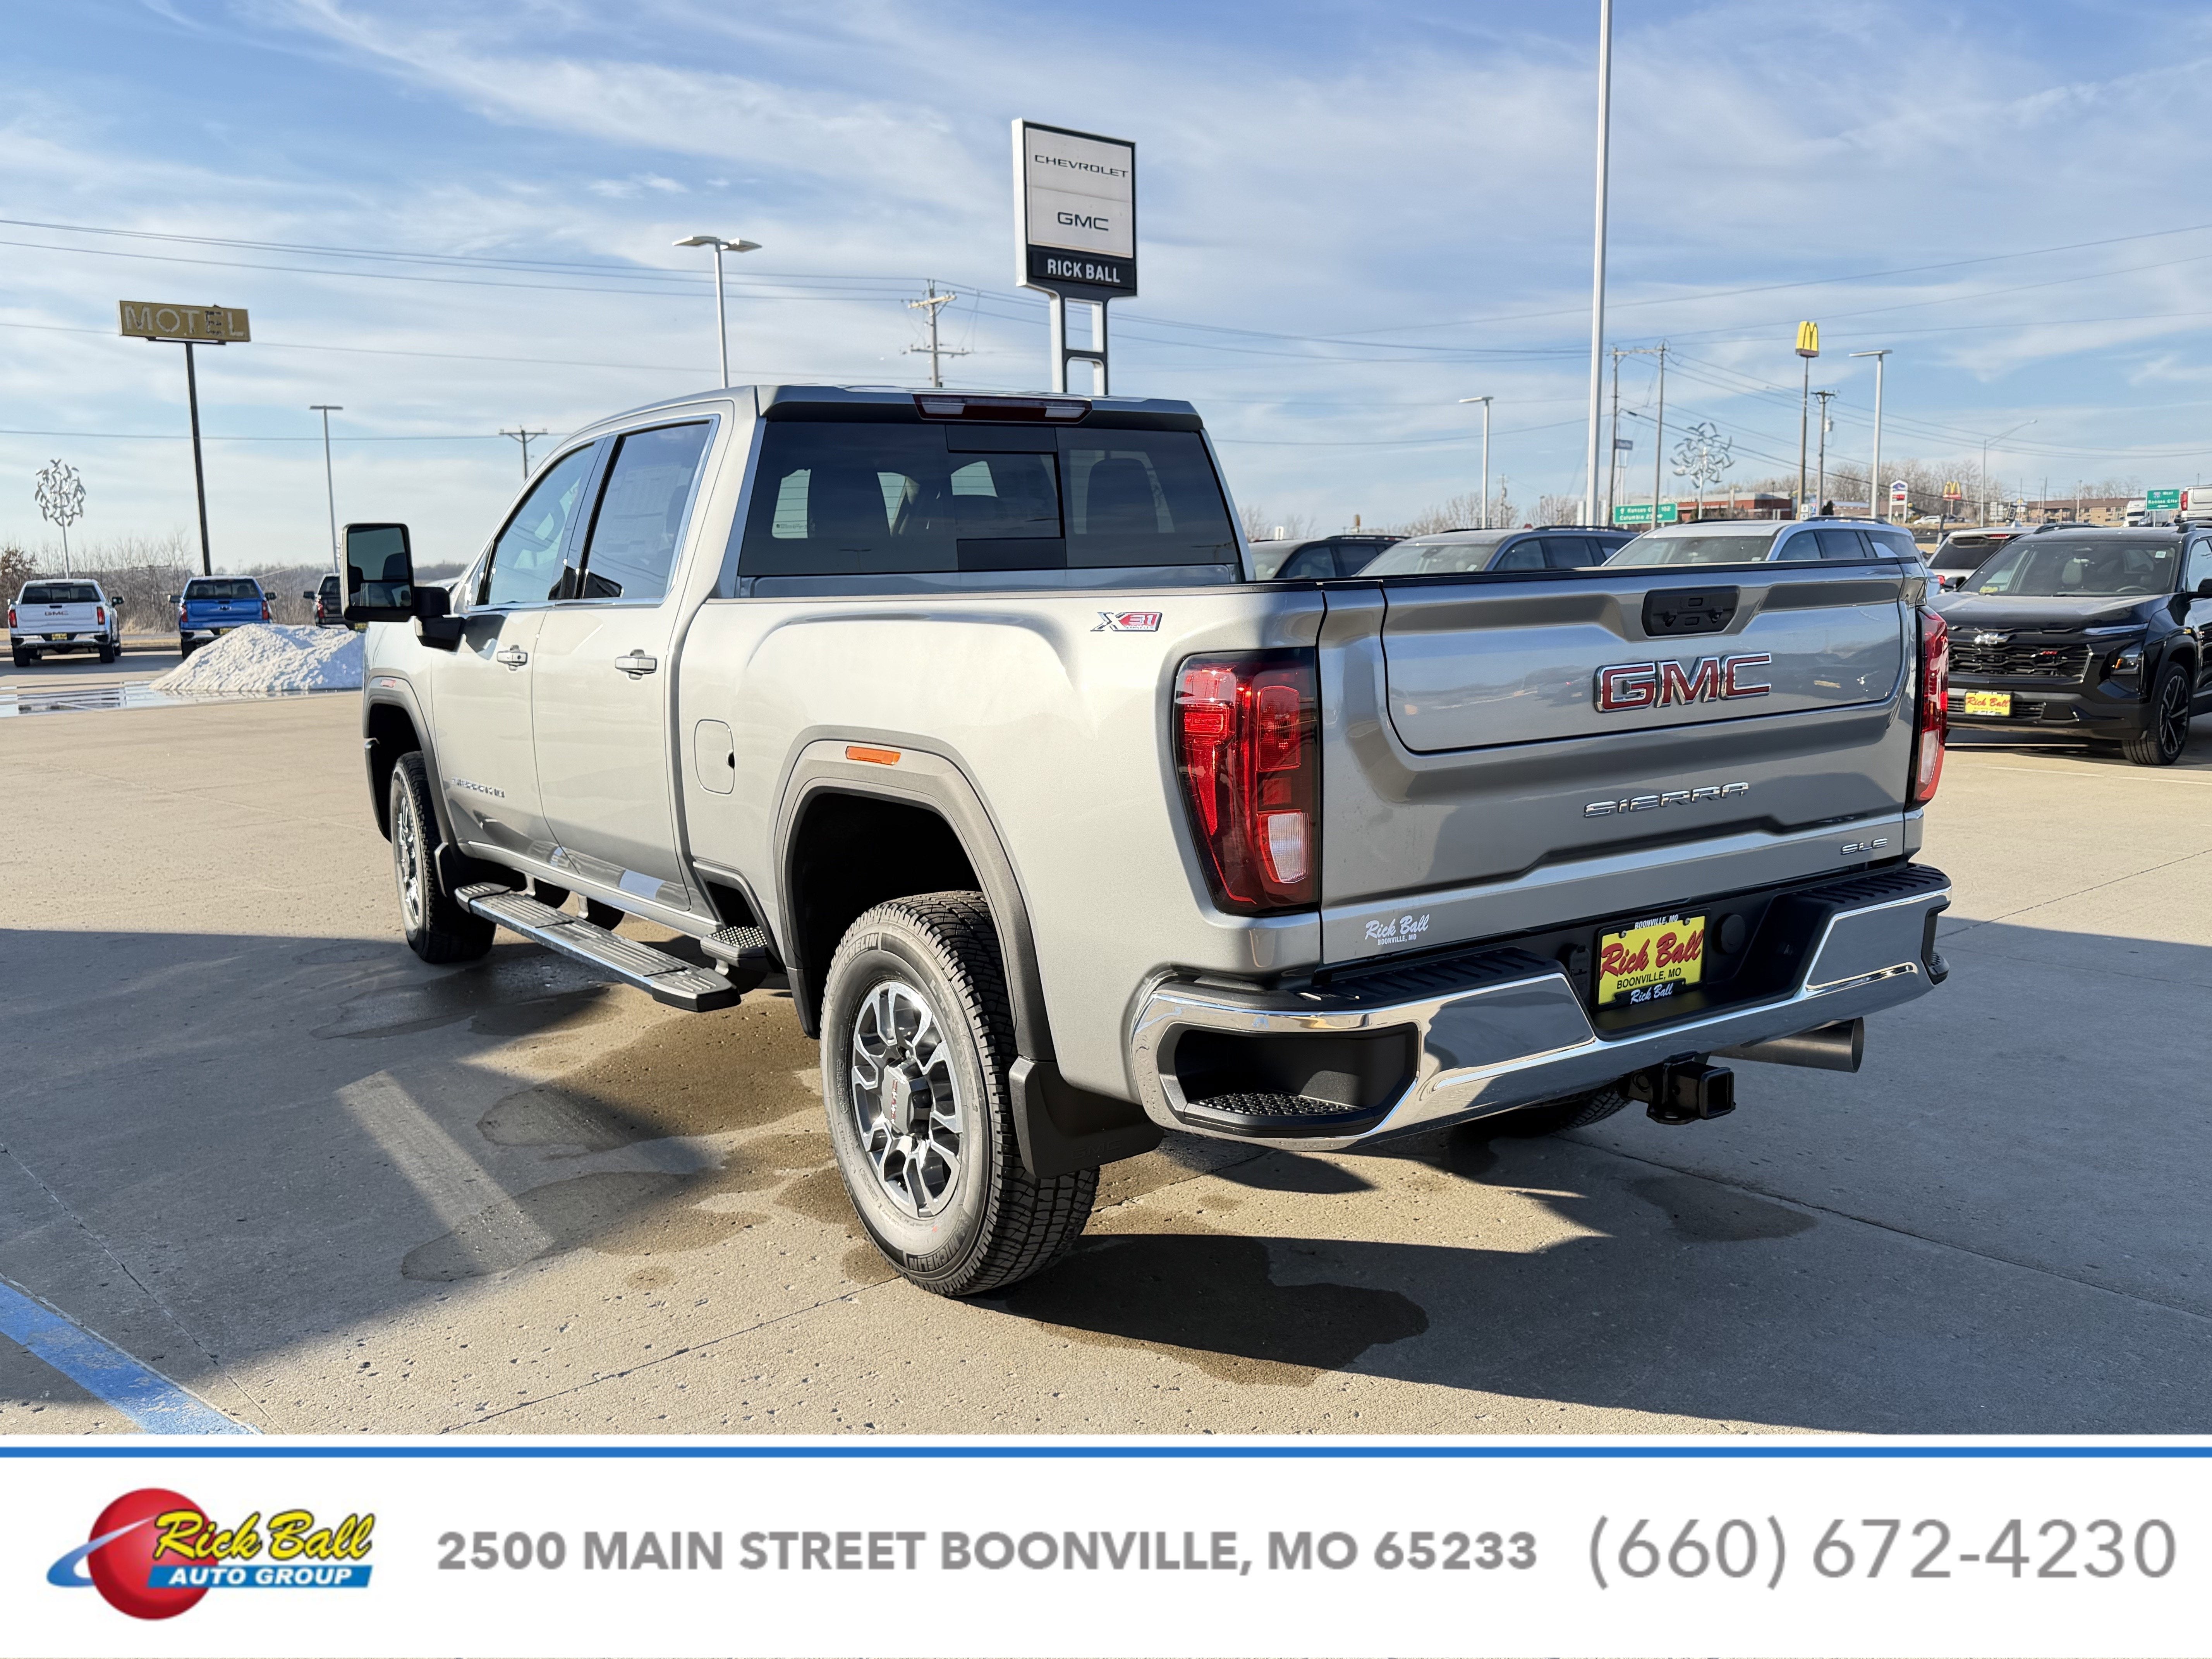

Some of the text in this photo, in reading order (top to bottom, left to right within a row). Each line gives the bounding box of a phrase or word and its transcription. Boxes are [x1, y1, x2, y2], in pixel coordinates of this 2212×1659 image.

[1035, 155, 1128, 178] CHEVROLET
[1057, 212, 1109, 231] GMC
[1047, 259, 1121, 283] RICK BALL
[125, 305, 244, 337] MOTEL
[1594, 651, 1772, 713] GMC
[1583, 781, 1749, 818] SIERRA
[1840, 838, 1888, 855] SLE
[1365, 914, 1430, 940] Rick Ball
[1634, 914, 1679, 929] BOONVILLE, MO
[1377, 935, 1407, 945] BOONVILLE,
[1600, 929, 1705, 981] Rick Ball
[1617, 967, 1681, 989] BOONVILLE, MO
[1630, 983, 1674, 1005] Rick Ball
